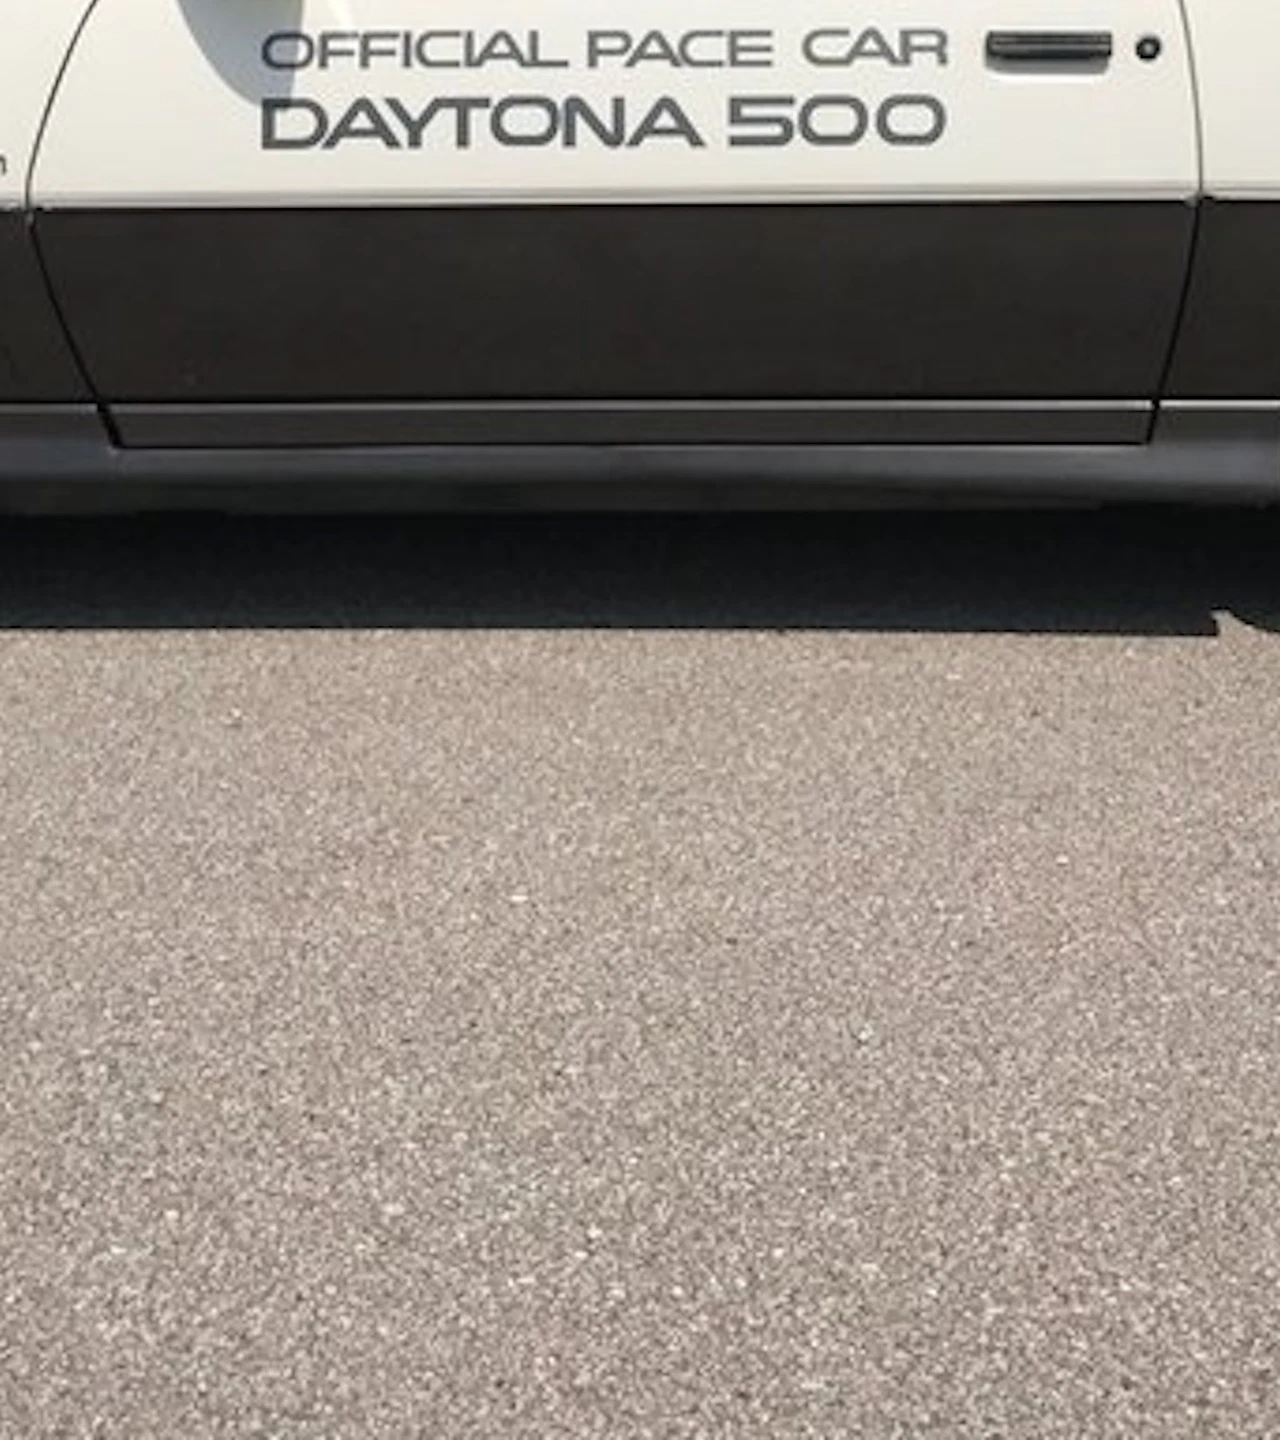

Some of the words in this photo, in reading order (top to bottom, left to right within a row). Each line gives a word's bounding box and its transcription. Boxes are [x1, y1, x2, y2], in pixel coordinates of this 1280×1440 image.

[261, 31, 568, 68] OFFICIAL
[587, 30, 773, 67] PACE
[802, 28, 949, 66] CAR
[261, 97, 705, 150] DAYTONA
[728, 95, 947, 148] 500
